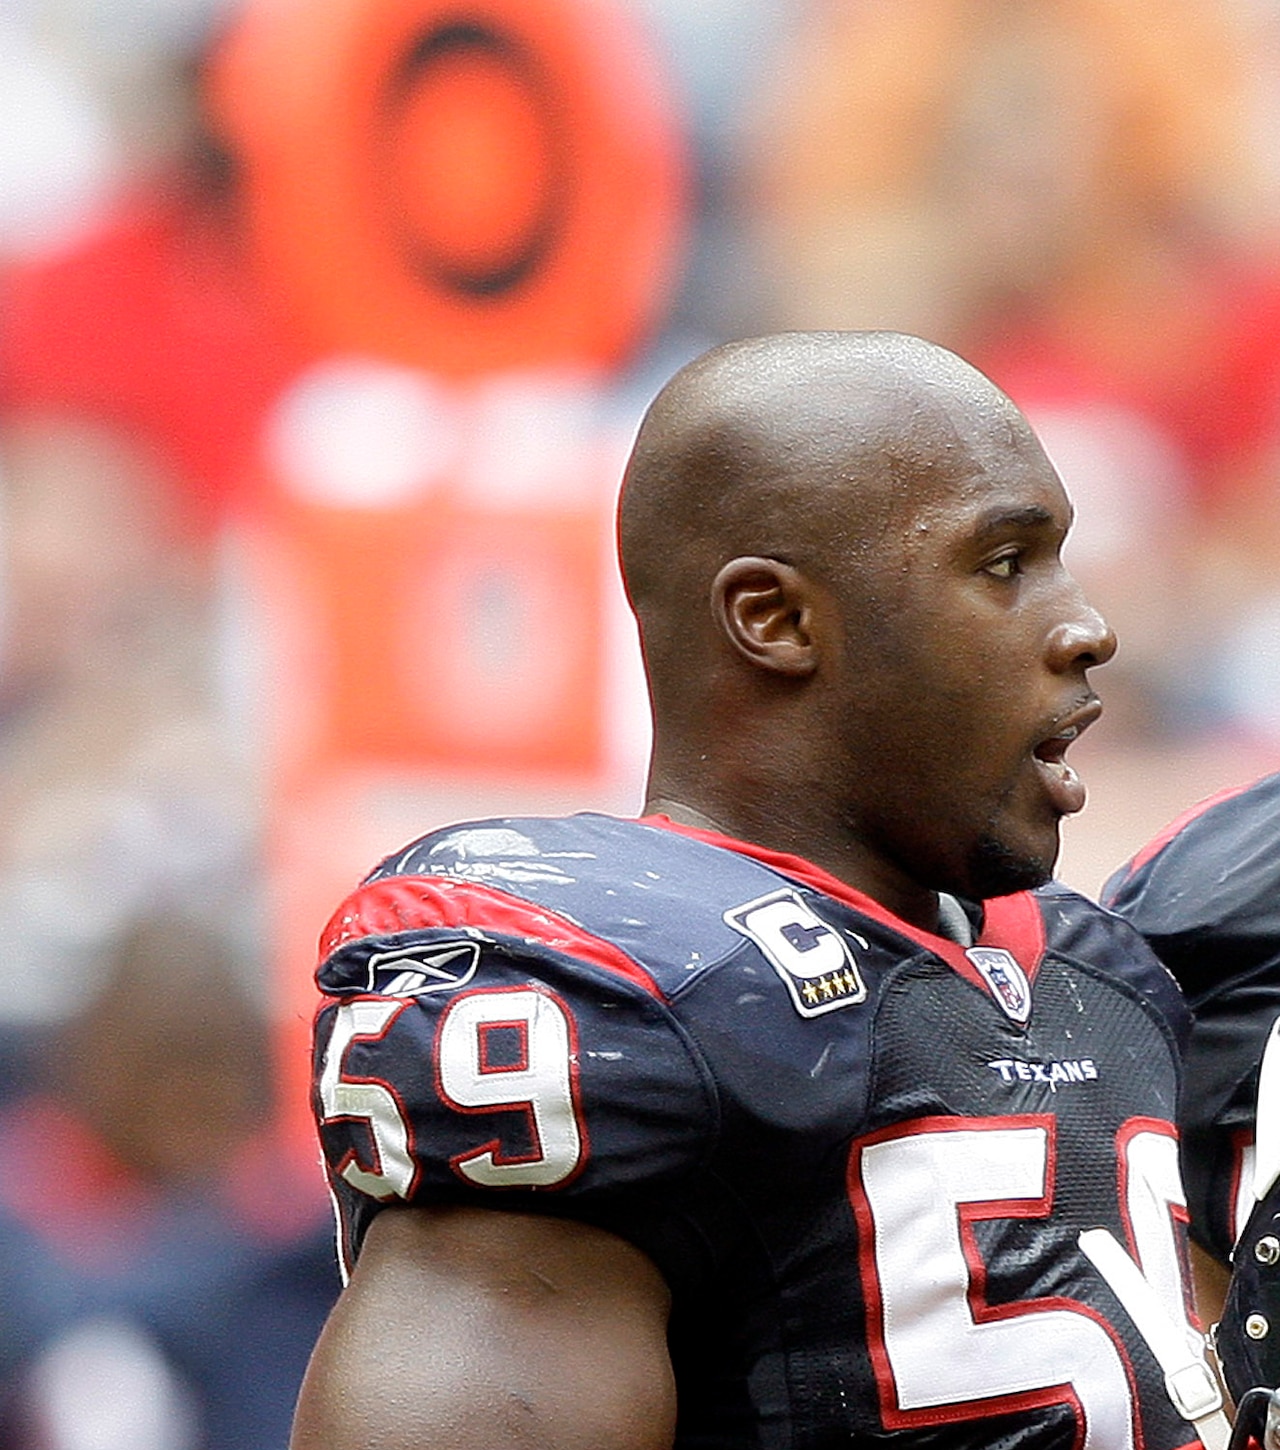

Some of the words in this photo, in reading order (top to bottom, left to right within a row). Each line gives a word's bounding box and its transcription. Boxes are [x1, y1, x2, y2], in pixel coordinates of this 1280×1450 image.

[745, 900, 845, 979] C
[310, 981, 591, 1202] 59
[986, 1058, 1098, 1082] TEXANS
